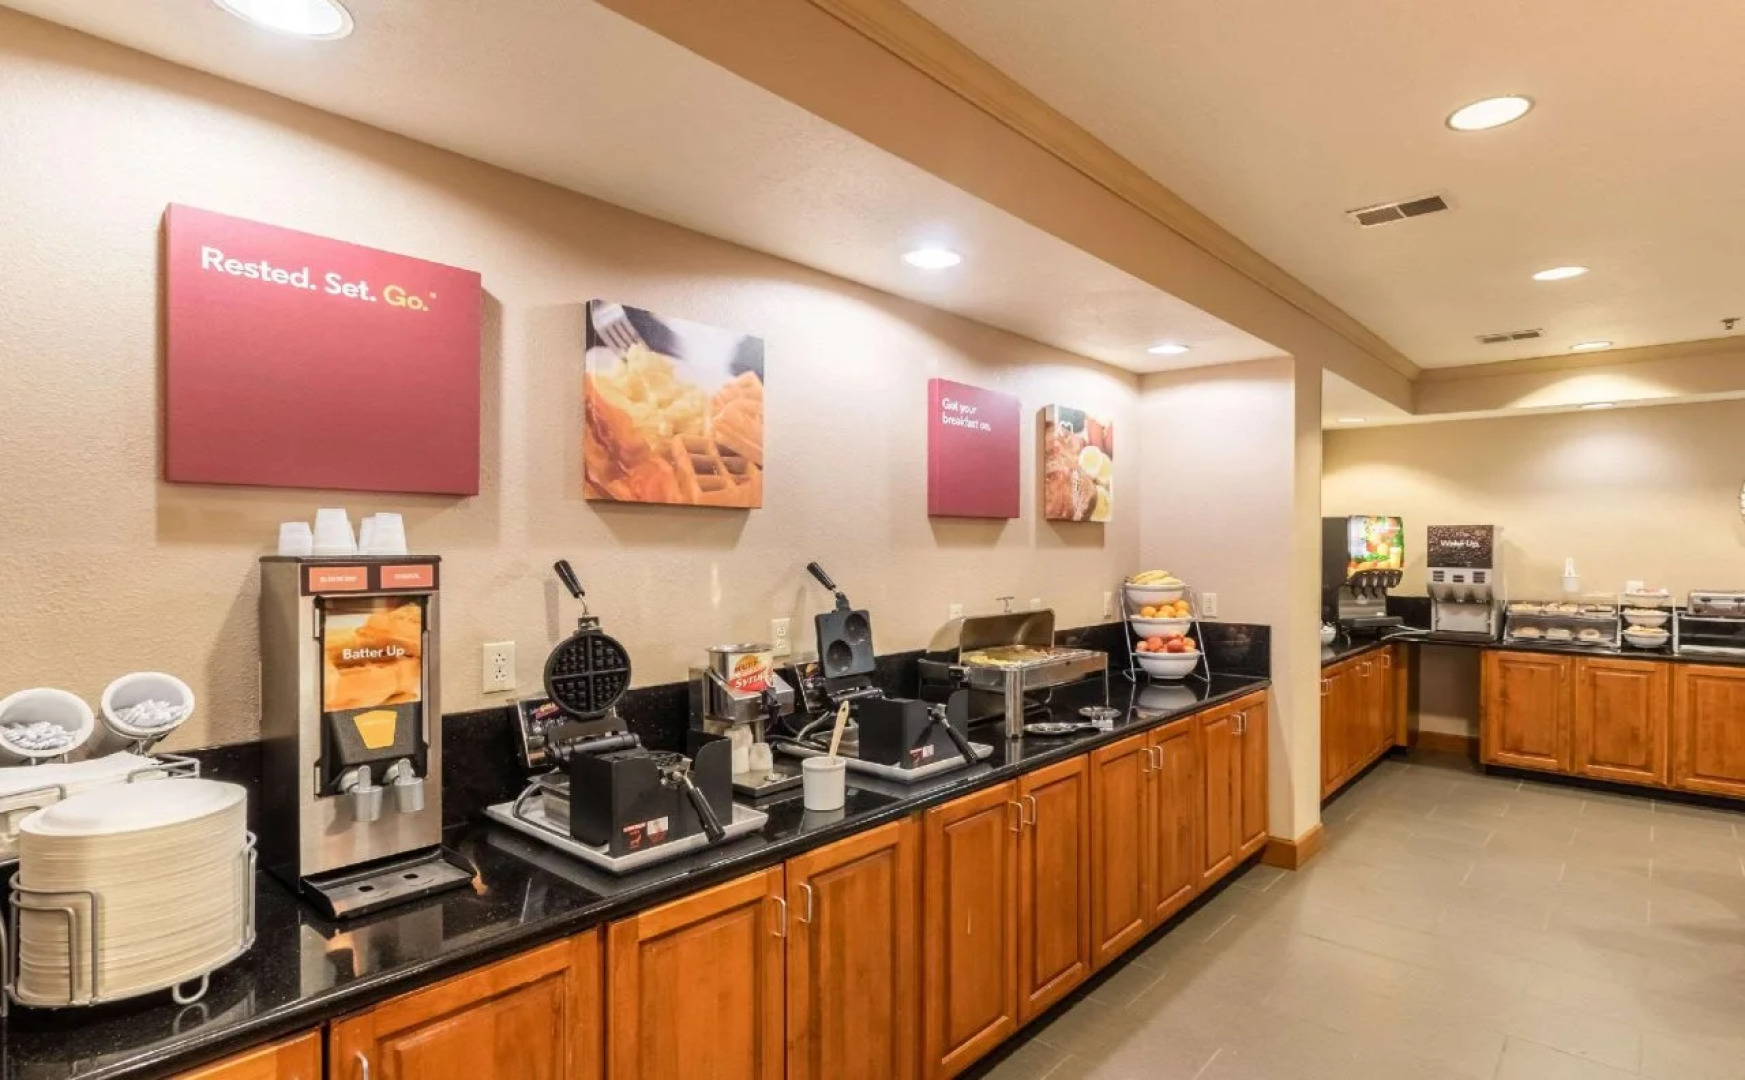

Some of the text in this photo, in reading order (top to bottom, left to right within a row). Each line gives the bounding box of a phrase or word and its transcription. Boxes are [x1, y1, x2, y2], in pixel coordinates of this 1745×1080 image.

[200, 246, 316, 290] Rested.
[324, 272, 376, 301] Set.
[941, 397, 976, 414] Get your
[941, 411, 979, 429] breakfast
[342, 645, 405, 660] Batter Up
